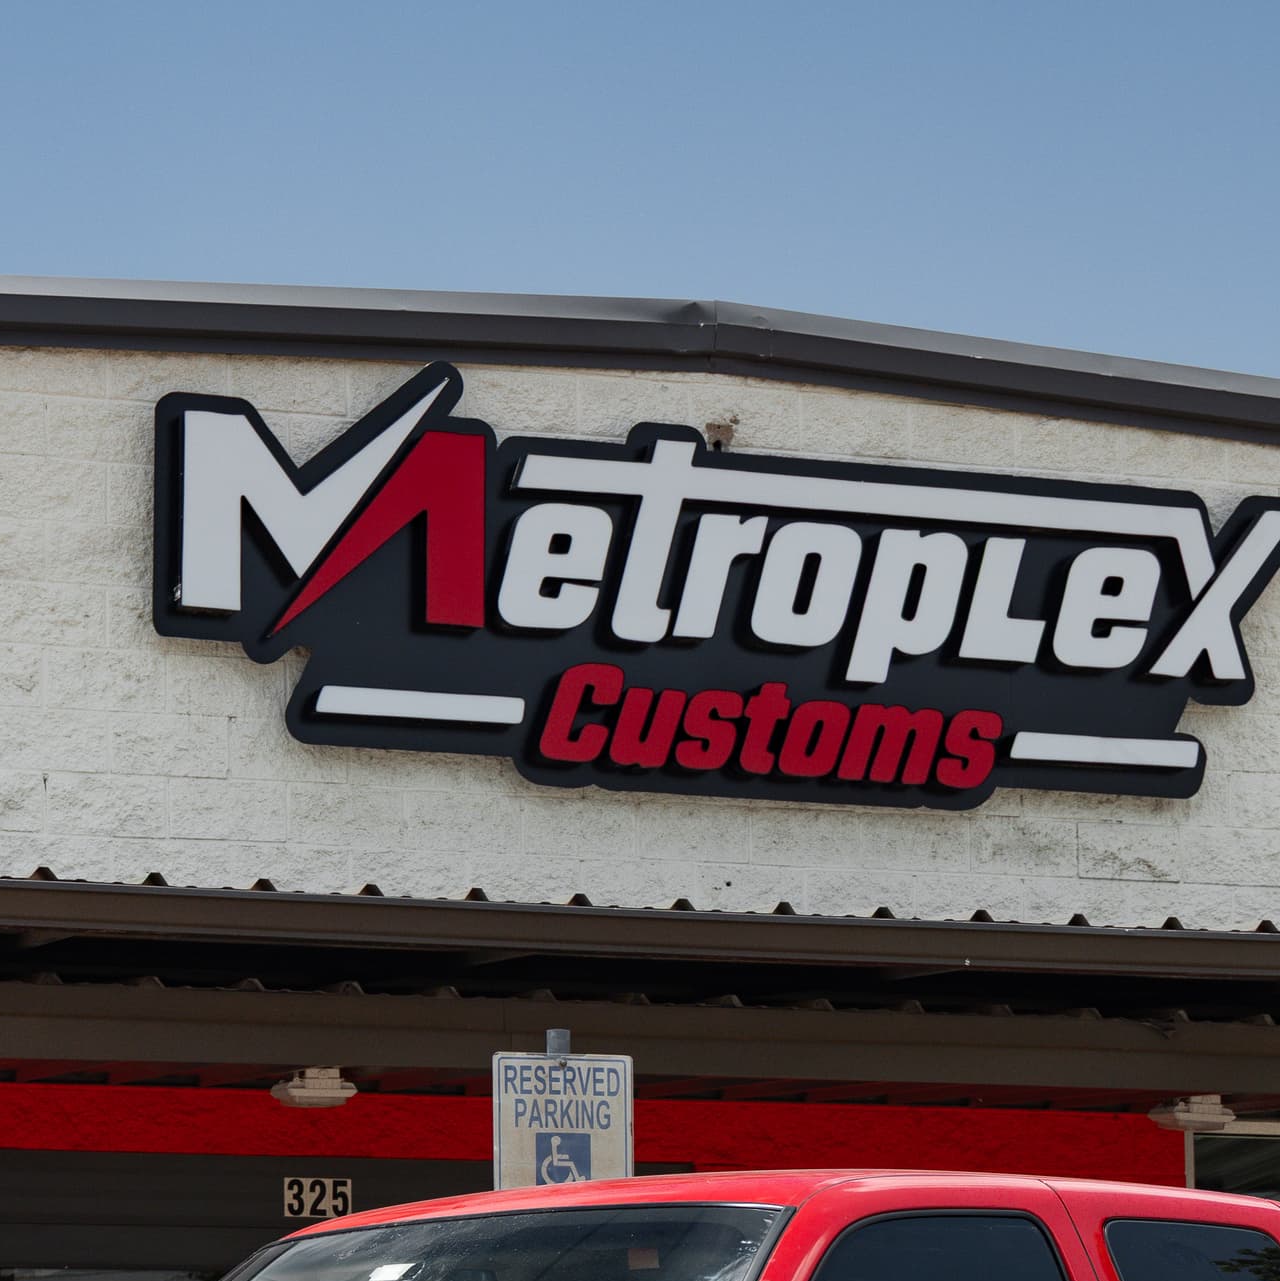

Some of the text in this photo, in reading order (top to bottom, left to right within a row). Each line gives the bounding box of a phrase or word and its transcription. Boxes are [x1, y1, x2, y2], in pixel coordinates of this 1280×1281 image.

[540, 663, 1003, 788] Customs
[504, 1065, 620, 1096] RESERVED
[514, 1098, 611, 1130] PARKING
[287, 1178, 349, 1217] 325
